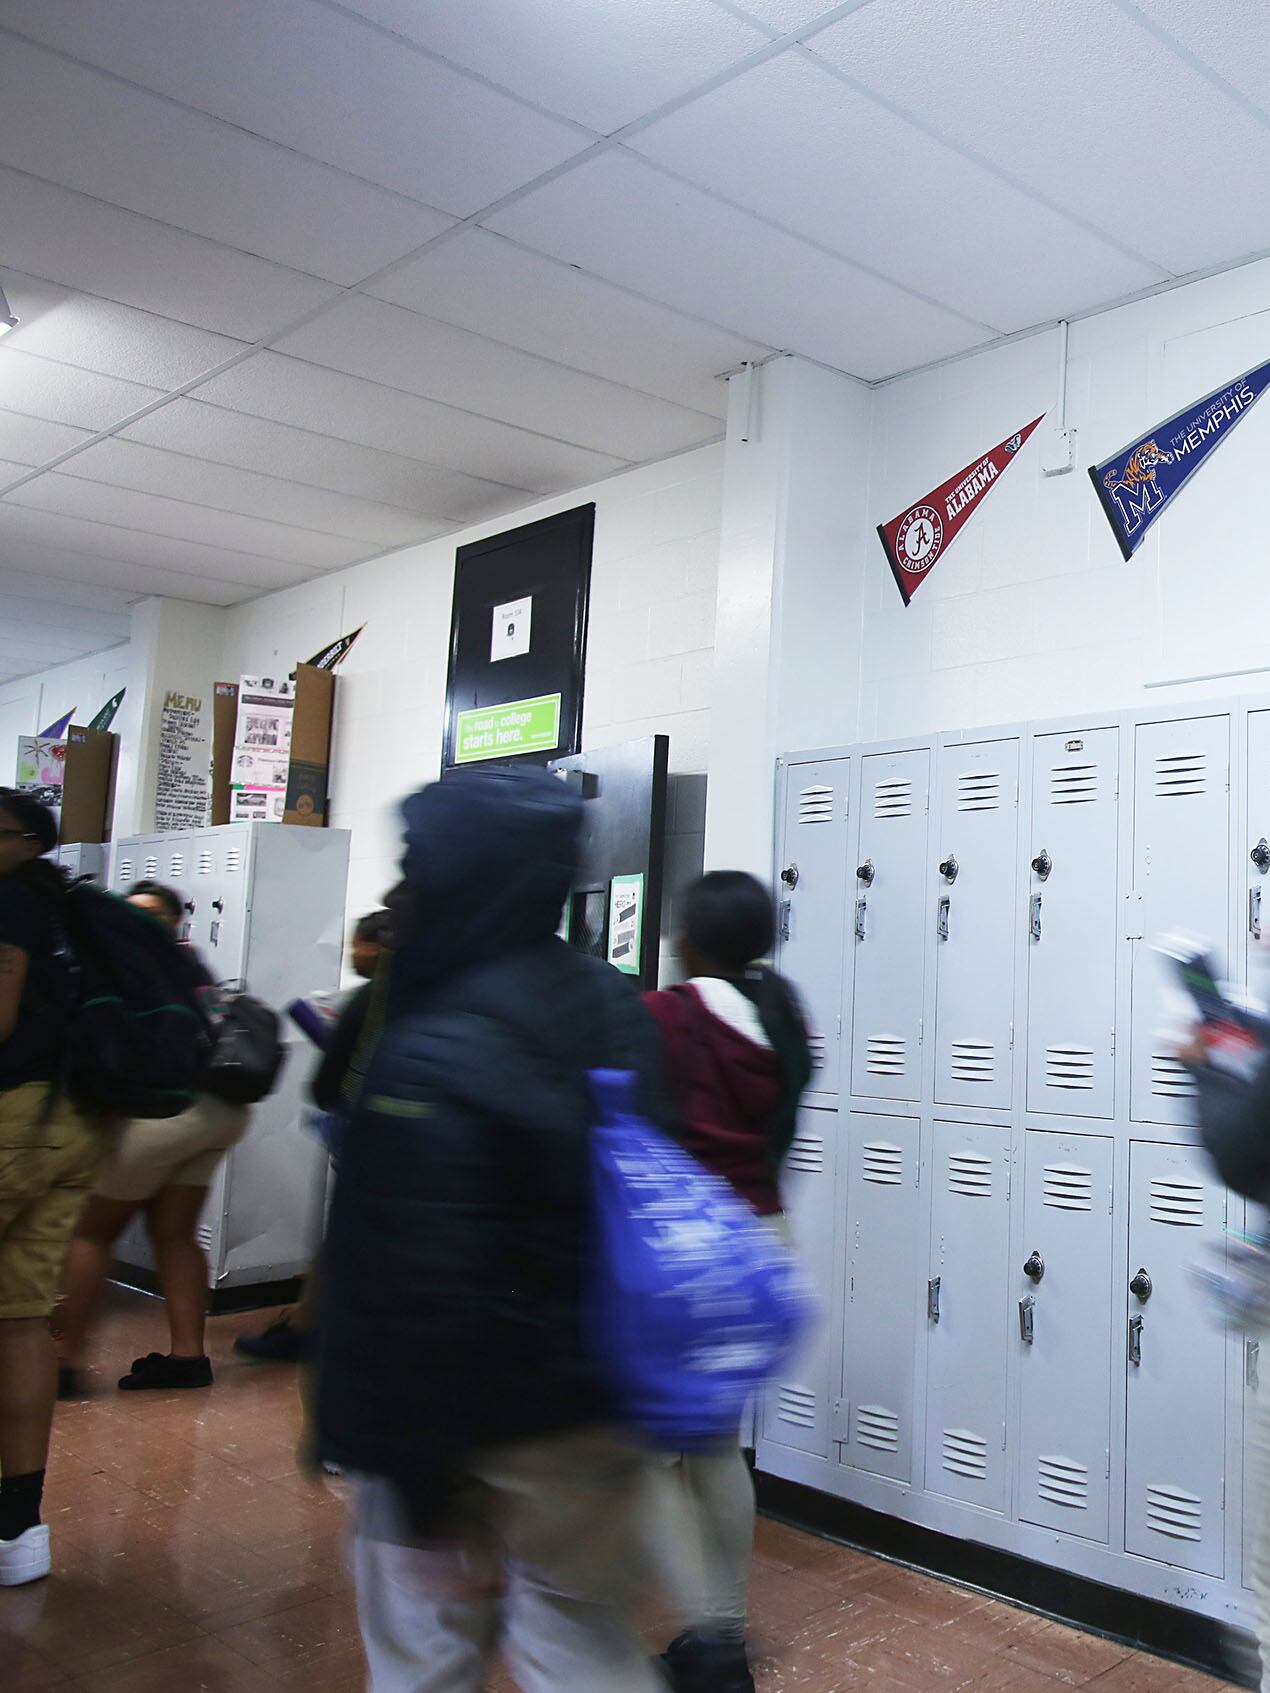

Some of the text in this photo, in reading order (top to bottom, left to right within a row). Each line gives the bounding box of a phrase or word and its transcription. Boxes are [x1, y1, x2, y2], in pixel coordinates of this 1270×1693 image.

[1170, 378, 1247, 446] THE UNIVERSITY OF
[1173, 386, 1255, 462] MEMPHIS
[945, 492, 956, 503] THE
[946, 461, 999, 520] ALABAMA
[1109, 479, 1165, 536] M
[898, 509, 935, 551] ALABAMA
[902, 552, 934, 570] CRIMSON
[164, 690, 202, 712] MENU
[474, 716, 494, 732] road
[500, 711, 533, 727] college
[463, 731, 494, 750] starts
[496, 728, 524, 745] here.
